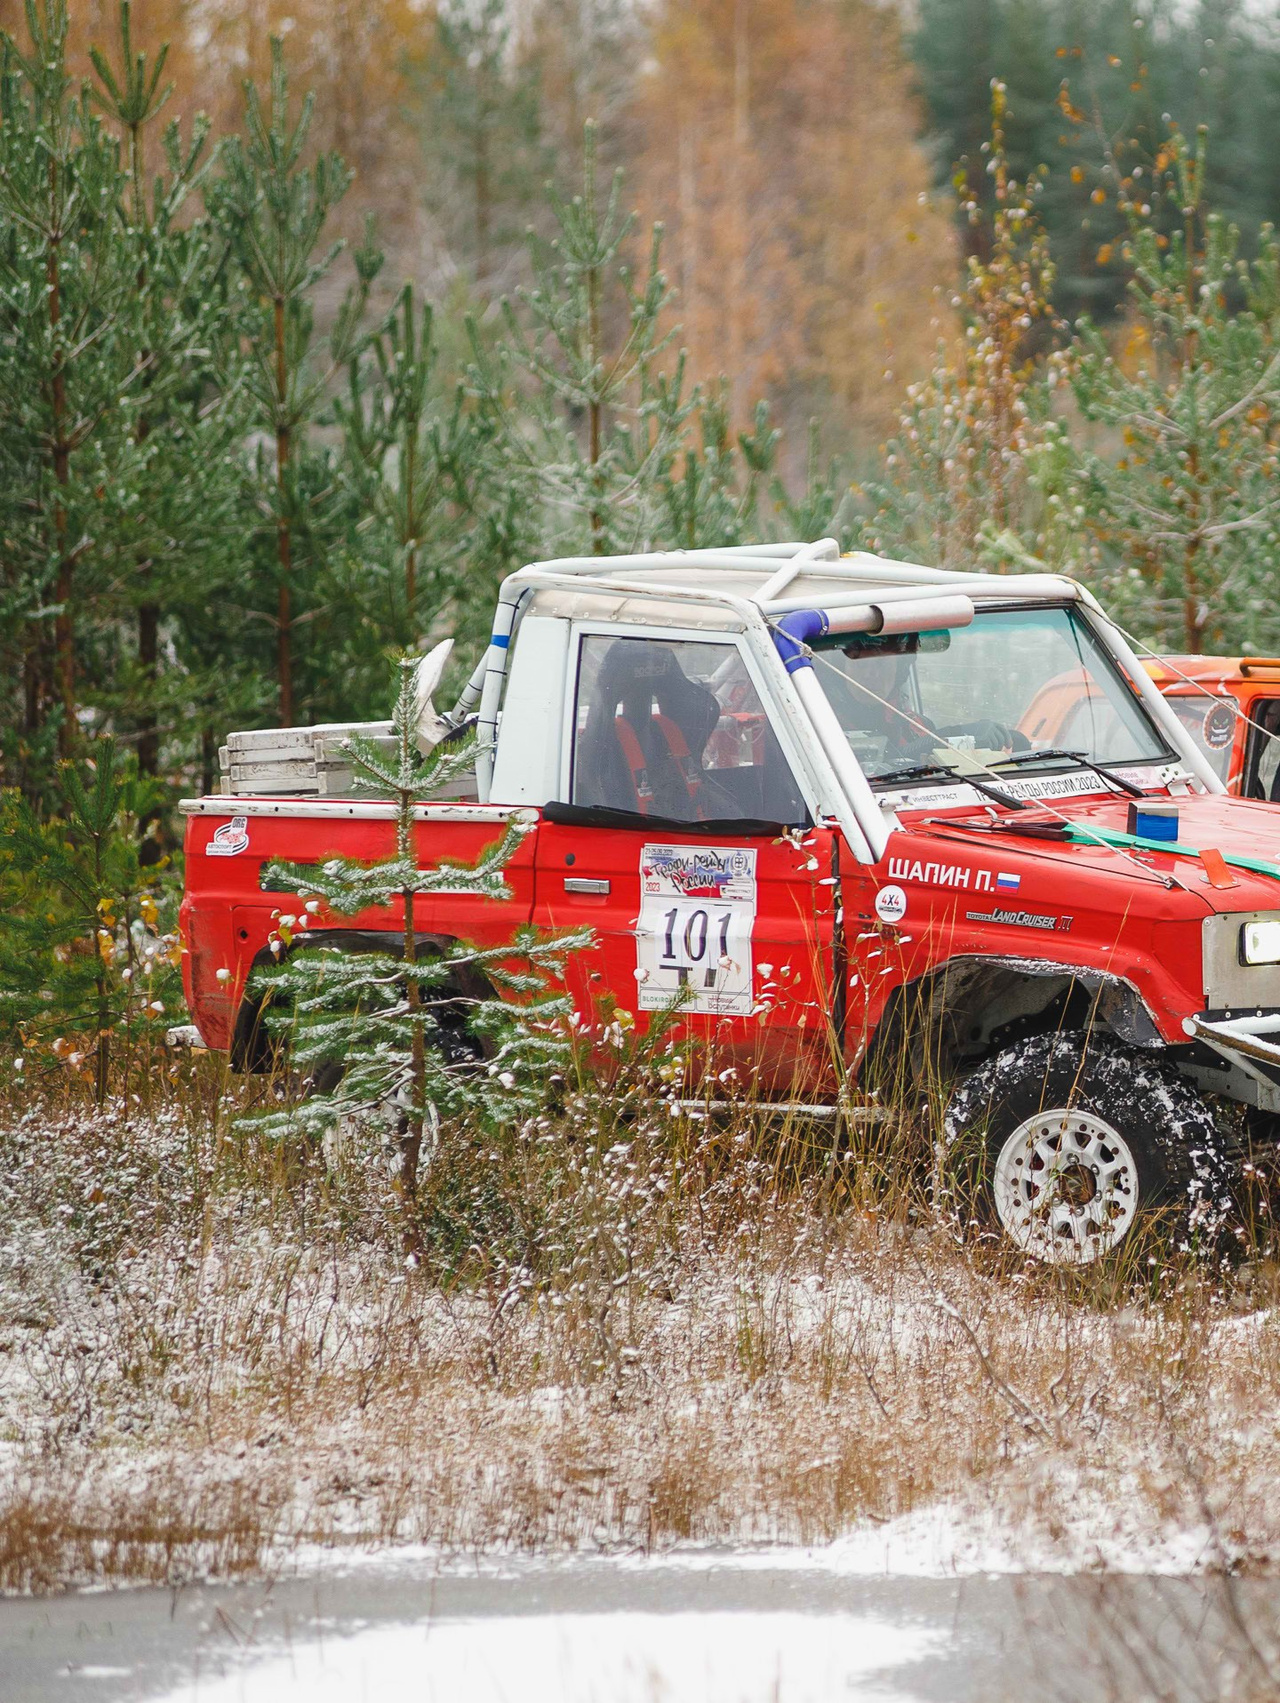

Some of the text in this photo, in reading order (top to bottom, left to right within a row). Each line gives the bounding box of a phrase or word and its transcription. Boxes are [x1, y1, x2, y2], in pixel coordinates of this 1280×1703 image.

[972, 781, 1043, 802] ТРИ-РЕЙДЫ
[232, 818, 246, 828] ORG
[888, 857, 995, 892] ШАПИН П.
[645, 882, 660, 892] 2023
[966, 912, 992, 920] TOYOTA
[662, 908, 732, 961] 101
